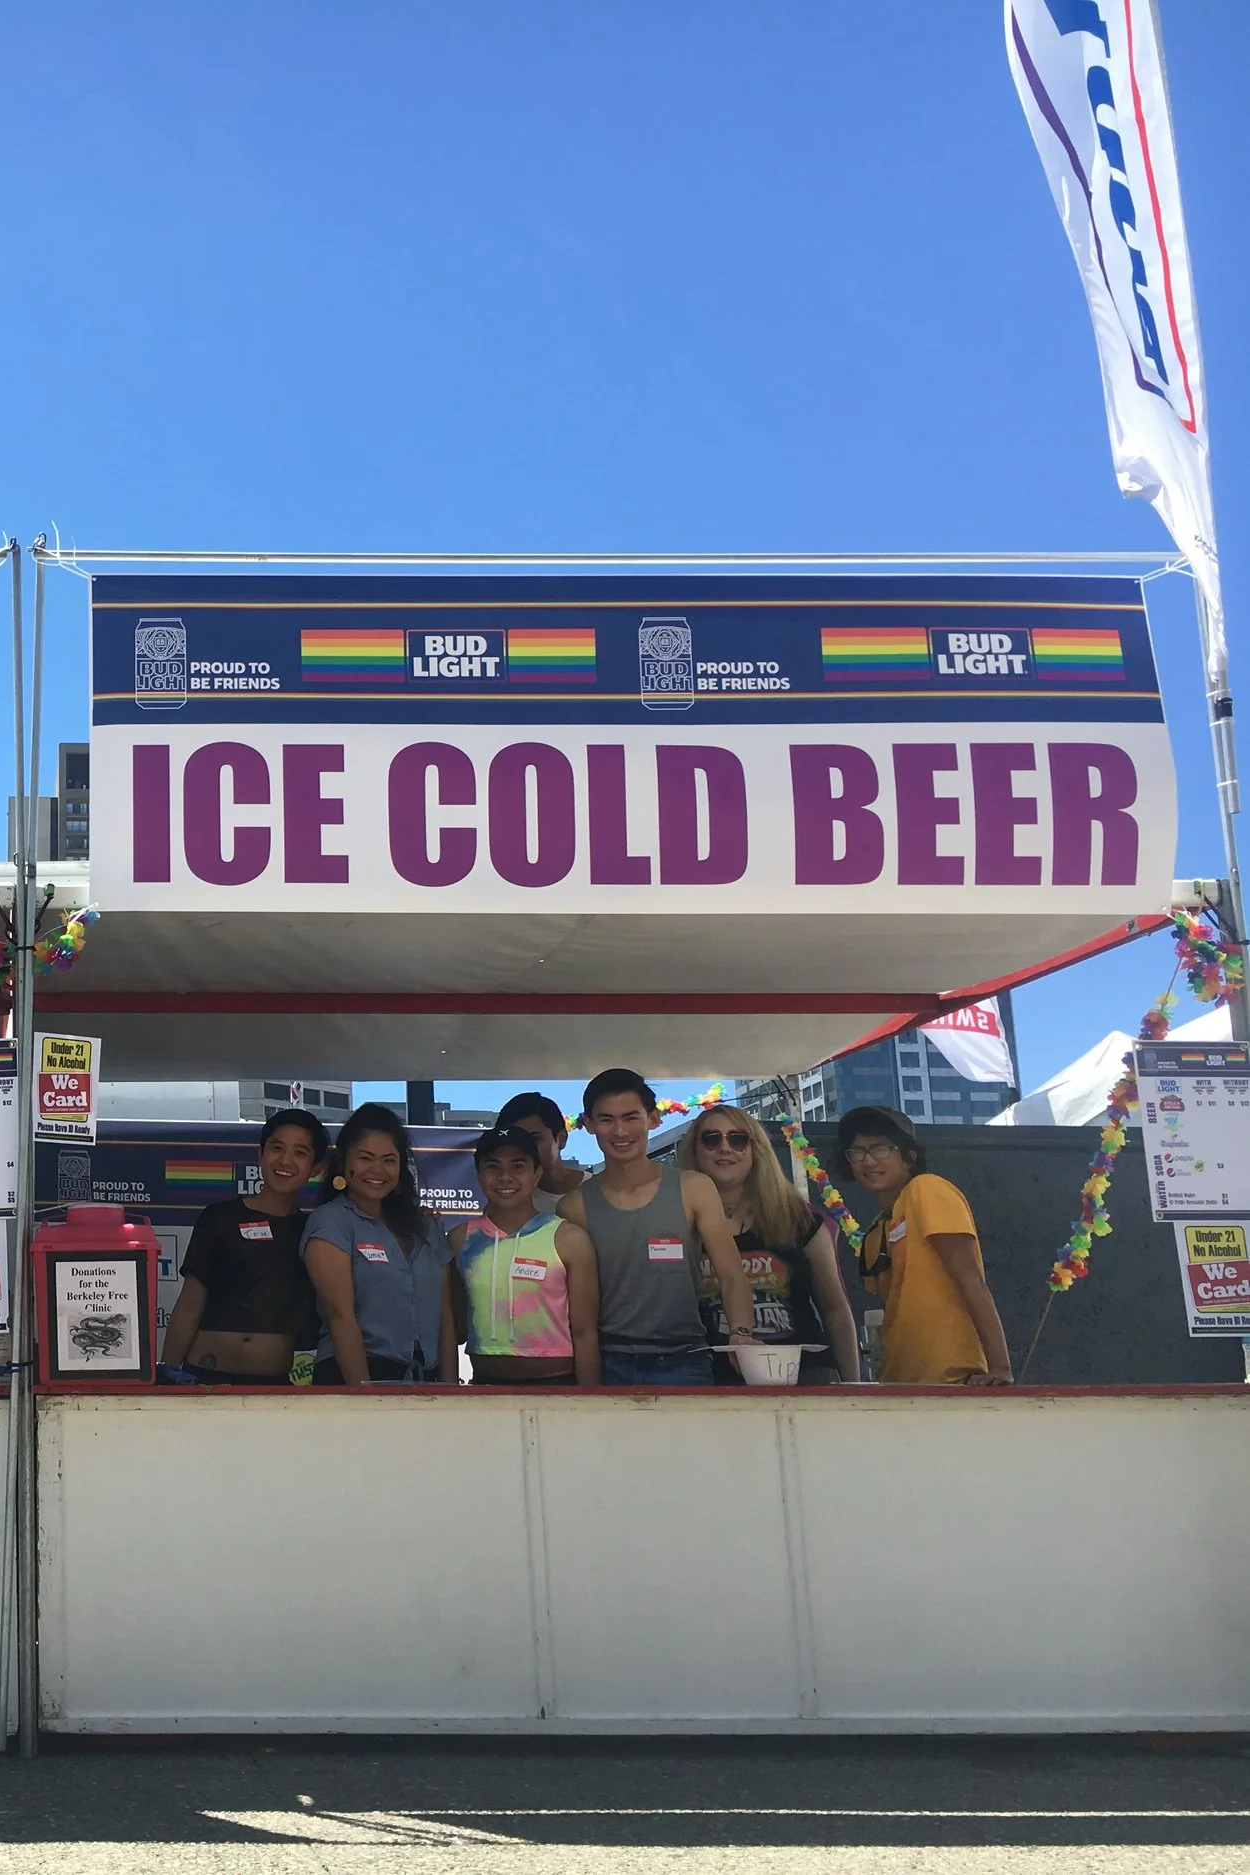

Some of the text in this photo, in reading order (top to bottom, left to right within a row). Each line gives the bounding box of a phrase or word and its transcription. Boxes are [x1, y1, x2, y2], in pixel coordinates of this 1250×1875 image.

[424, 635, 487, 656] BUD
[948, 633, 1012, 654] BUD
[191, 662, 270, 674] PROUD TO
[413, 656, 499, 677] LIGHT
[697, 662, 779, 674] PROUD TO
[937, 654, 1026, 675] LIGHT
[191, 678, 280, 690] BE FRIENDS
[698, 678, 790, 690] BE FRIENDS
[133, 741, 1139, 887] ICE COLD BEER
[51, 1042, 84, 1056] Under 21
[47, 1055, 86, 1070] No Alcohol
[51, 1075, 78, 1090] We
[43, 1092, 87, 1107] Card
[37, 1122, 90, 1135] Please Have ID Ready
[93, 1182, 145, 1191] PROUD TO
[238, 1180, 263, 1195] LIG
[93, 1192, 150, 1202] BE FRIENDS
[420, 1189, 473, 1198] PROUD TO
[435, 1200, 479, 1209] FRIENDS
[1195, 1230, 1235, 1242] Under 21
[1193, 1245, 1241, 1257] No Alcohol
[71, 1268, 116, 1276] Donations
[1202, 1263, 1238, 1280] We
[79, 1280, 109, 1288] for the
[67, 1291, 128, 1301] Berkeley Free
